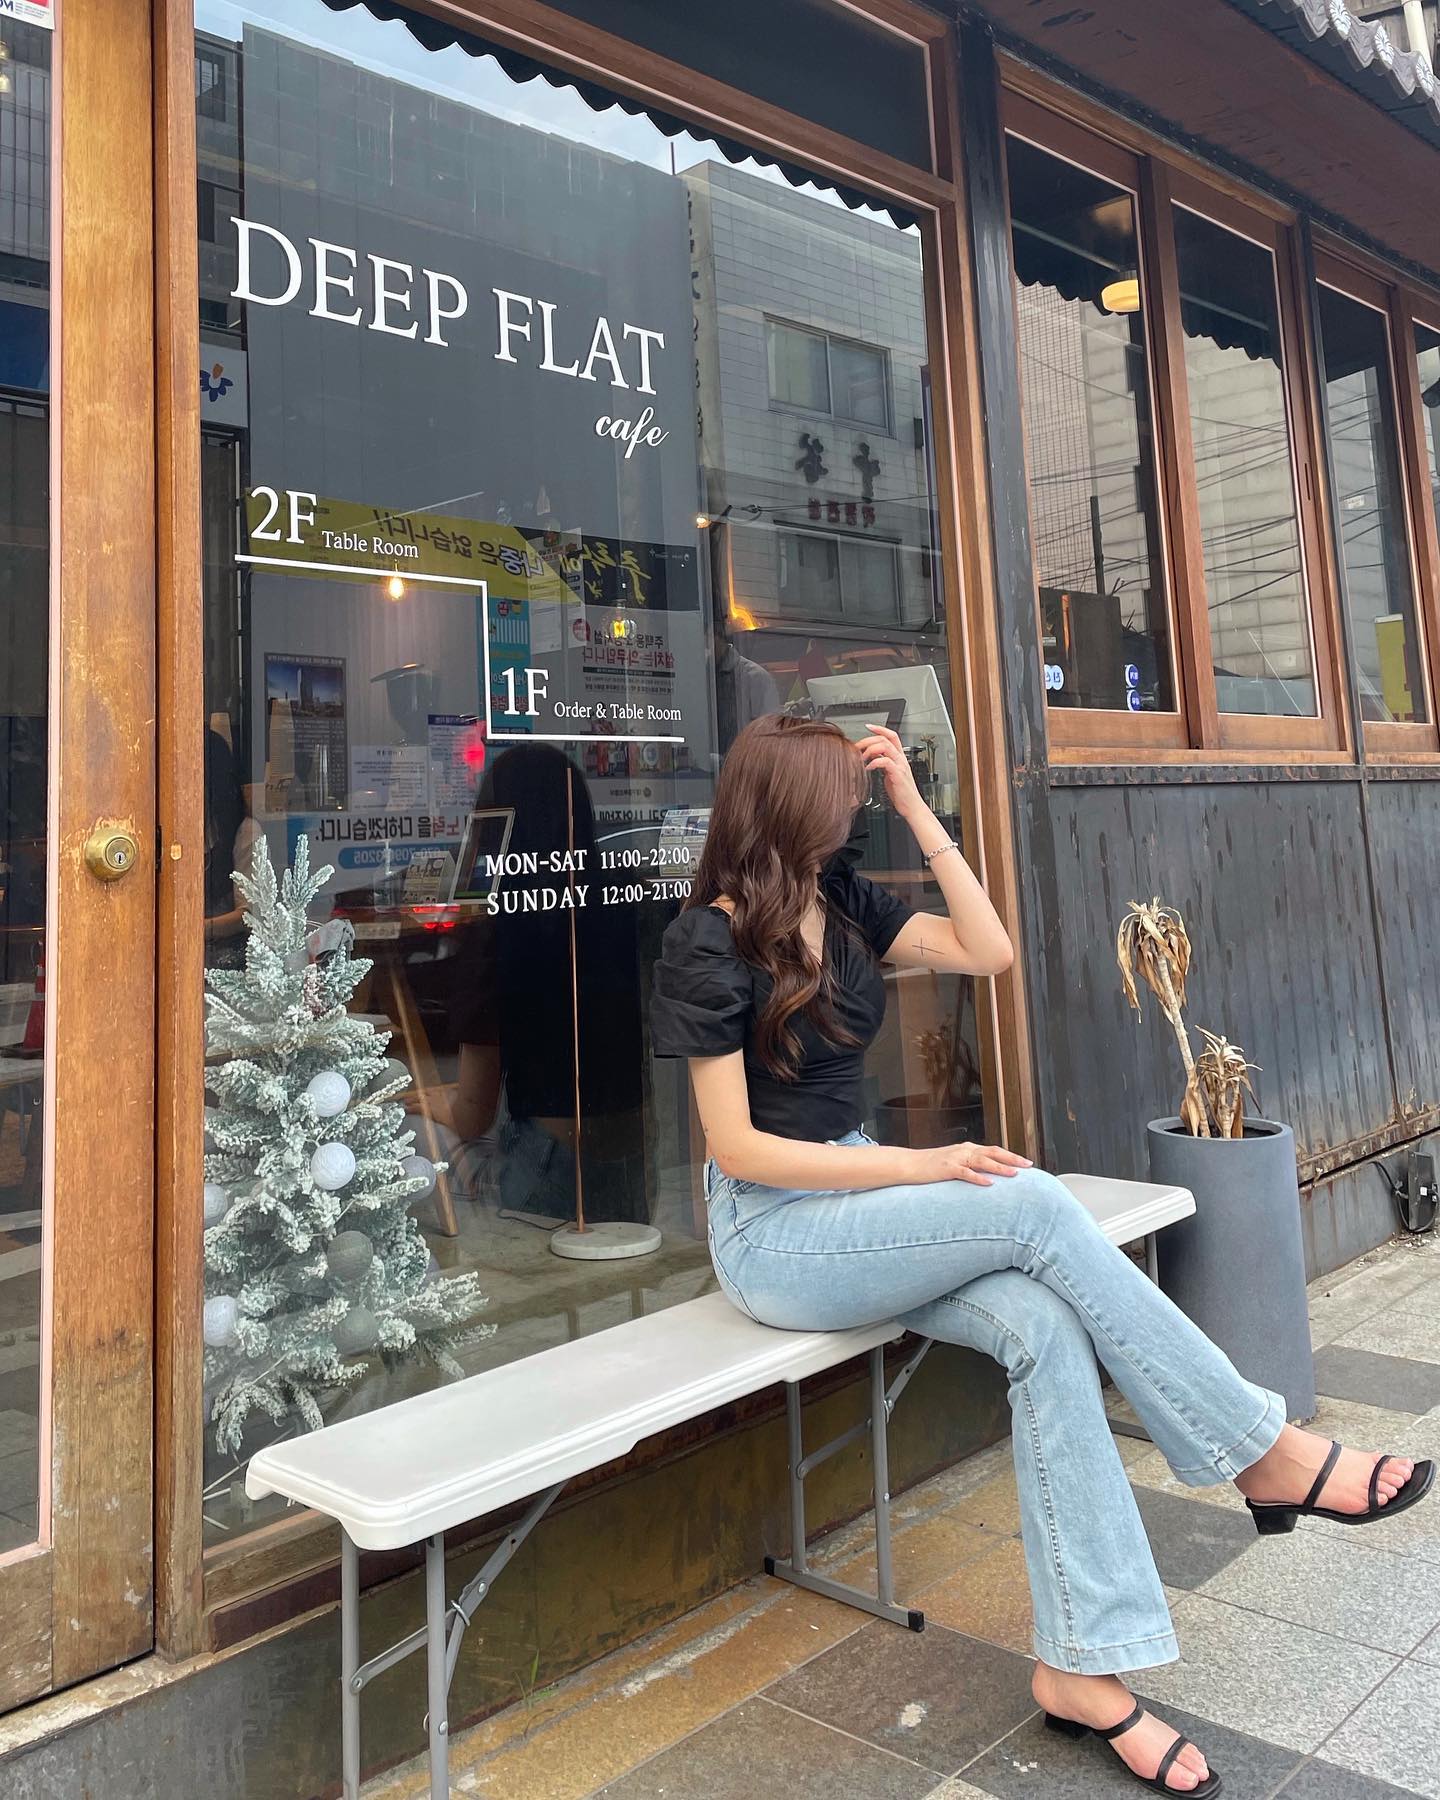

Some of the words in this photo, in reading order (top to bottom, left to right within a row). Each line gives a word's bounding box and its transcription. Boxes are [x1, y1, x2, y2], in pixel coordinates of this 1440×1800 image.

[230, 216, 468, 346] DEEP
[492, 288, 665, 396] FLAT
[595, 407, 668, 459] cafe
[250, 486, 318, 544] 2F
[322, 529, 368, 552] Table
[373, 538, 419, 559] Room
[502, 667, 550, 716] 1F
[554, 701, 591, 720] Order
[596, 703, 607, 720] &
[610, 703, 643, 720] Table
[647, 705, 682, 722] Room
[485, 849, 587, 877] MON-SAT
[600, 847, 690, 870] 11:00-22:00
[486, 886, 590, 915] SUNDAY
[601, 881, 692, 905] 12:00-21:00
